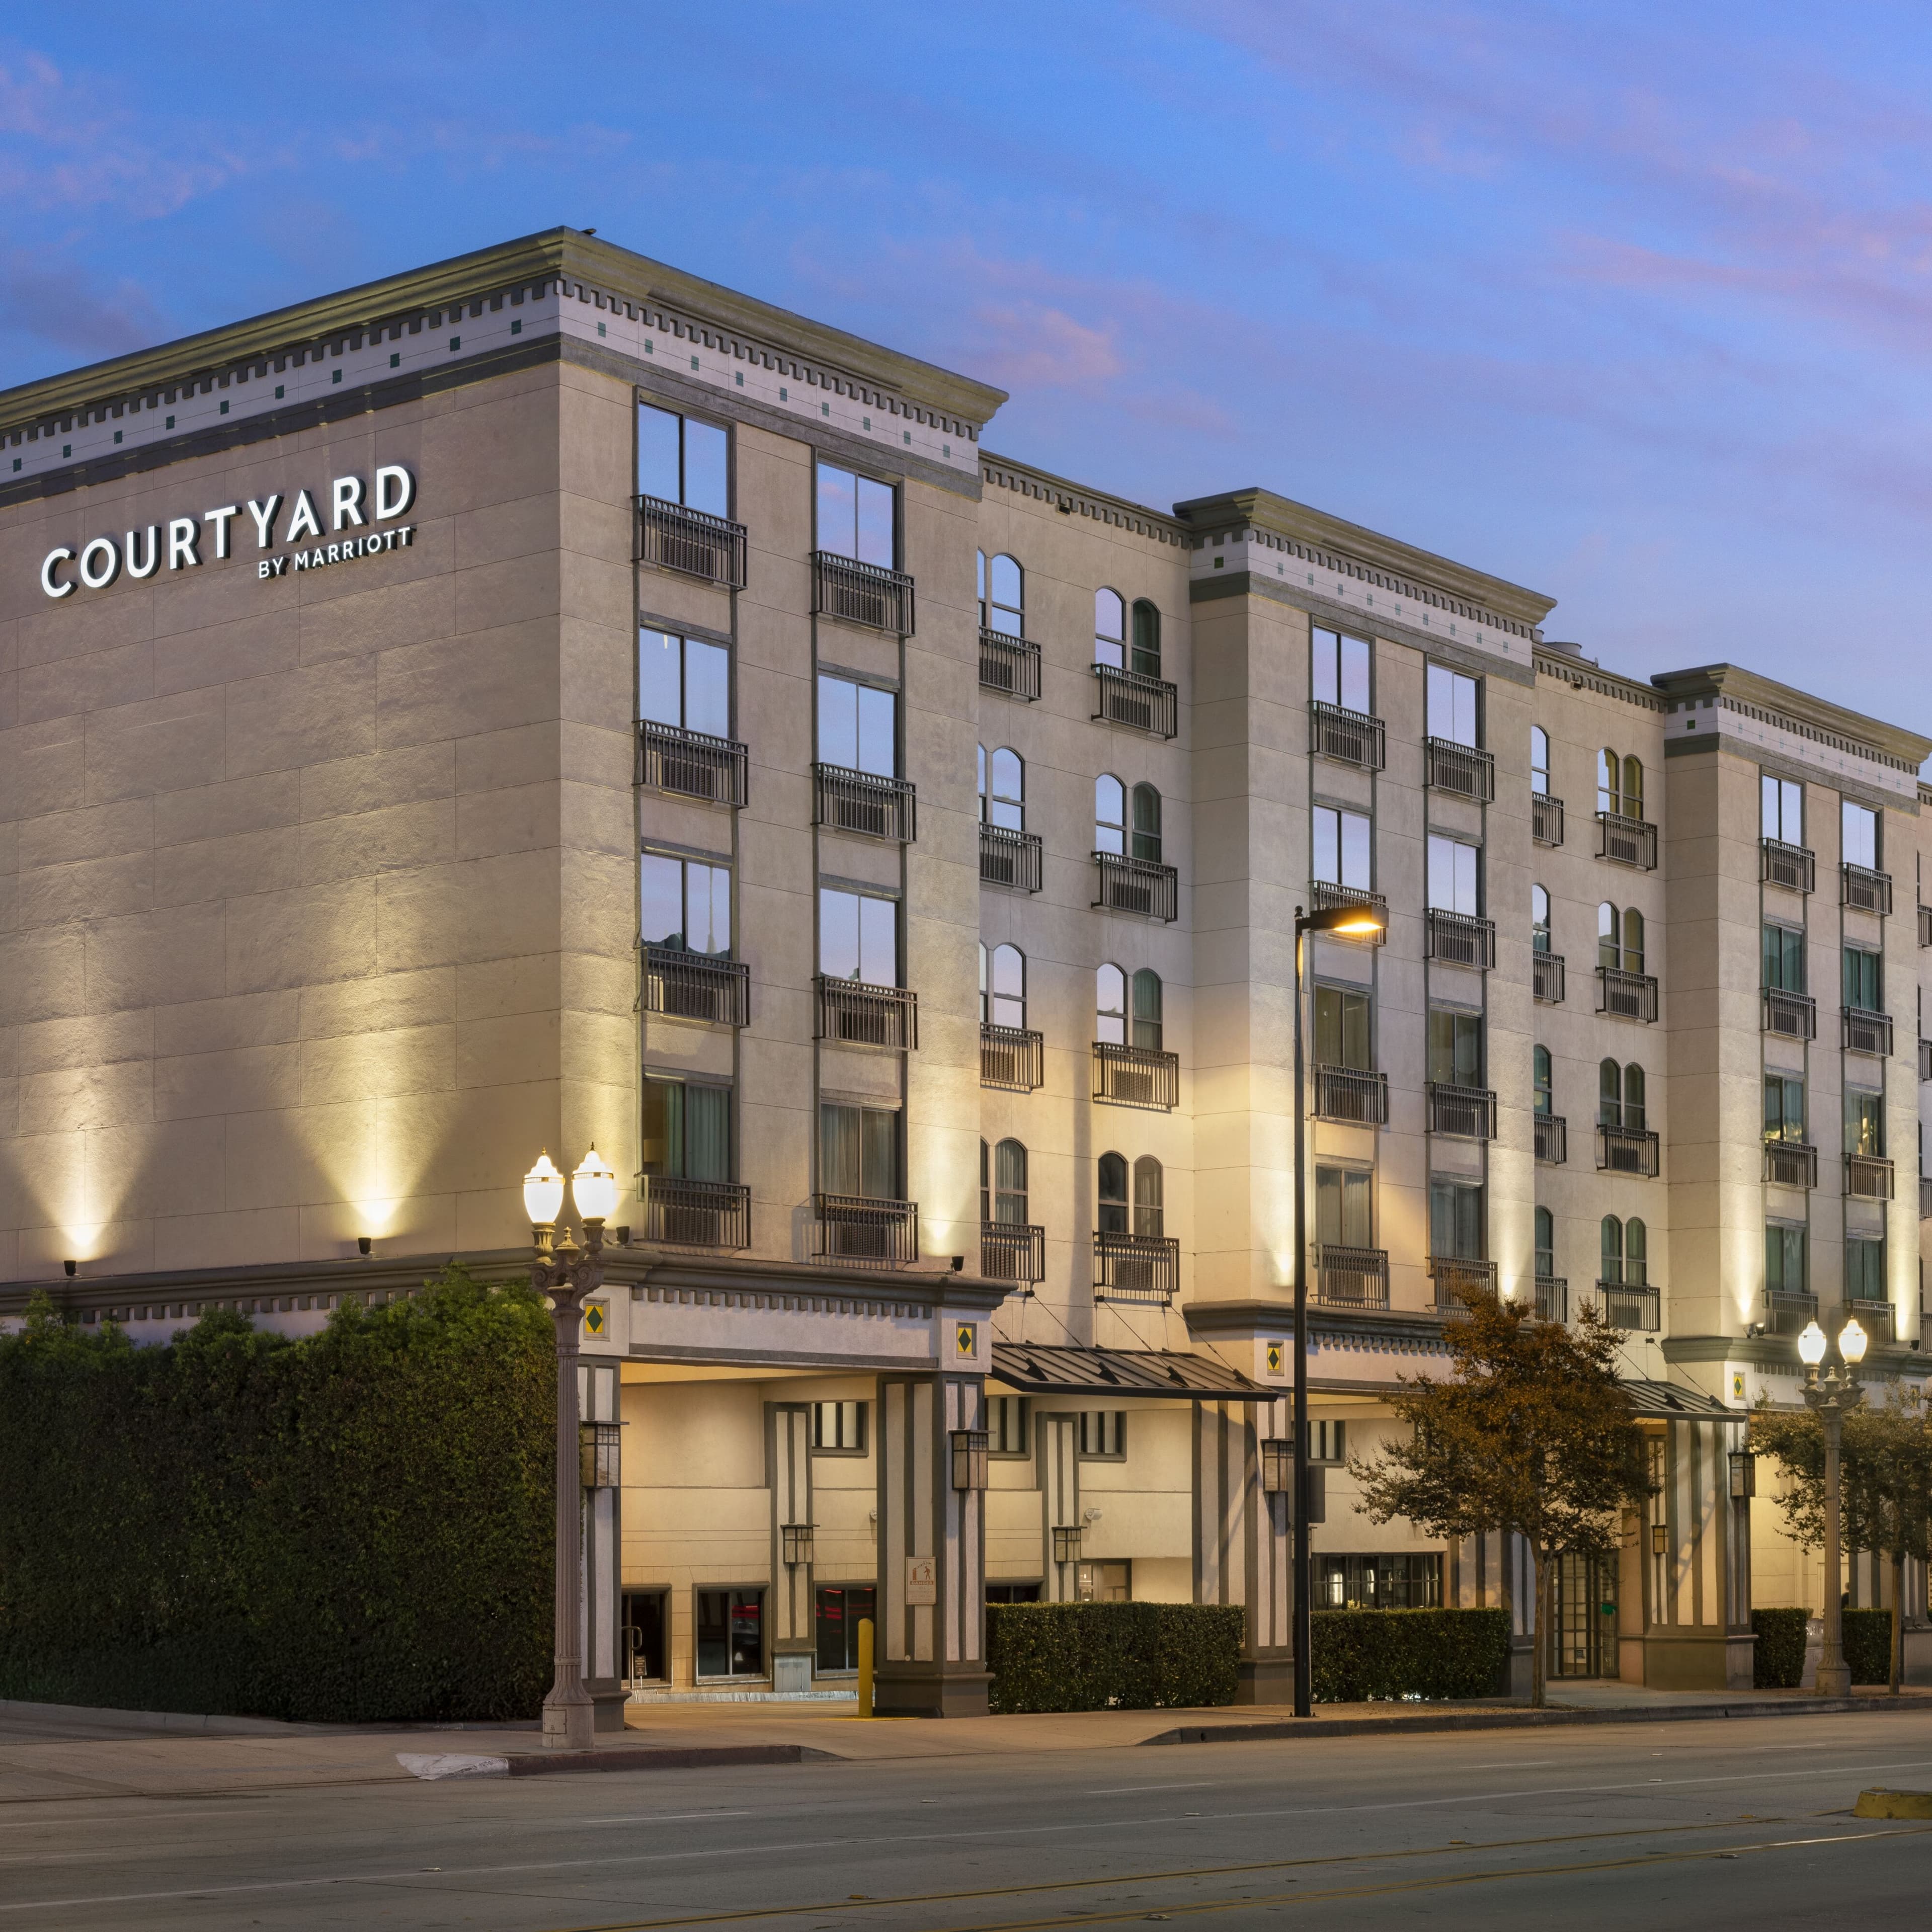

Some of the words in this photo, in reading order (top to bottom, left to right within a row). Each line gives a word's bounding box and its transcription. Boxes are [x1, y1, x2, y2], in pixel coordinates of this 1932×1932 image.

[41, 465, 412, 598] COURTYARD
[258, 556, 285, 579] BY
[294, 527, 411, 571] MARRIOTT
